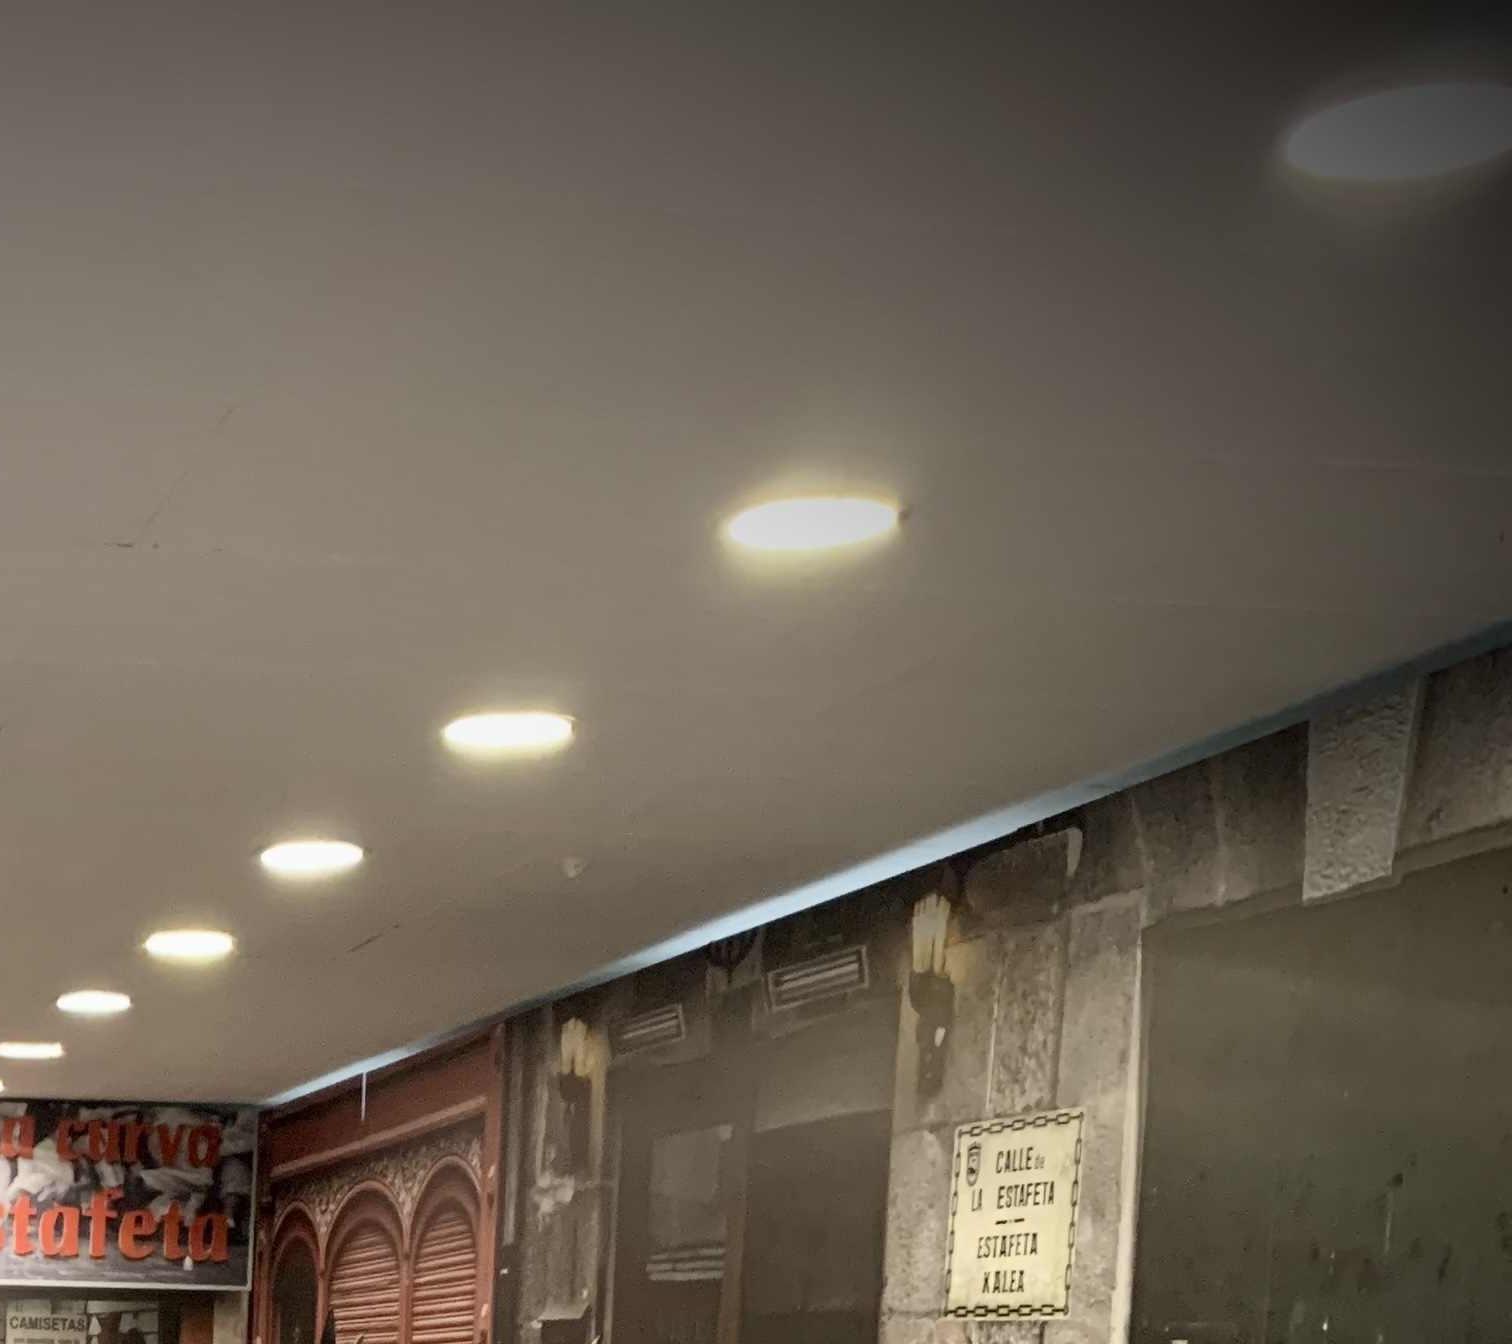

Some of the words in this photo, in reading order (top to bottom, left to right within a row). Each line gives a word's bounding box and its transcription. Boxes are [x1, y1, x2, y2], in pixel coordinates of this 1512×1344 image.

[55, 1117, 222, 1169] curva
[995, 1146, 1033, 1175] CALLE
[971, 1188, 983, 1212] LA
[996, 1181, 1055, 1210] ESTAFETA
[977, 1232, 1038, 1260] ESTAFETA
[982, 1269, 1025, 1294] KALEA
[9, 1315, 85, 1332] CAMISETAS
